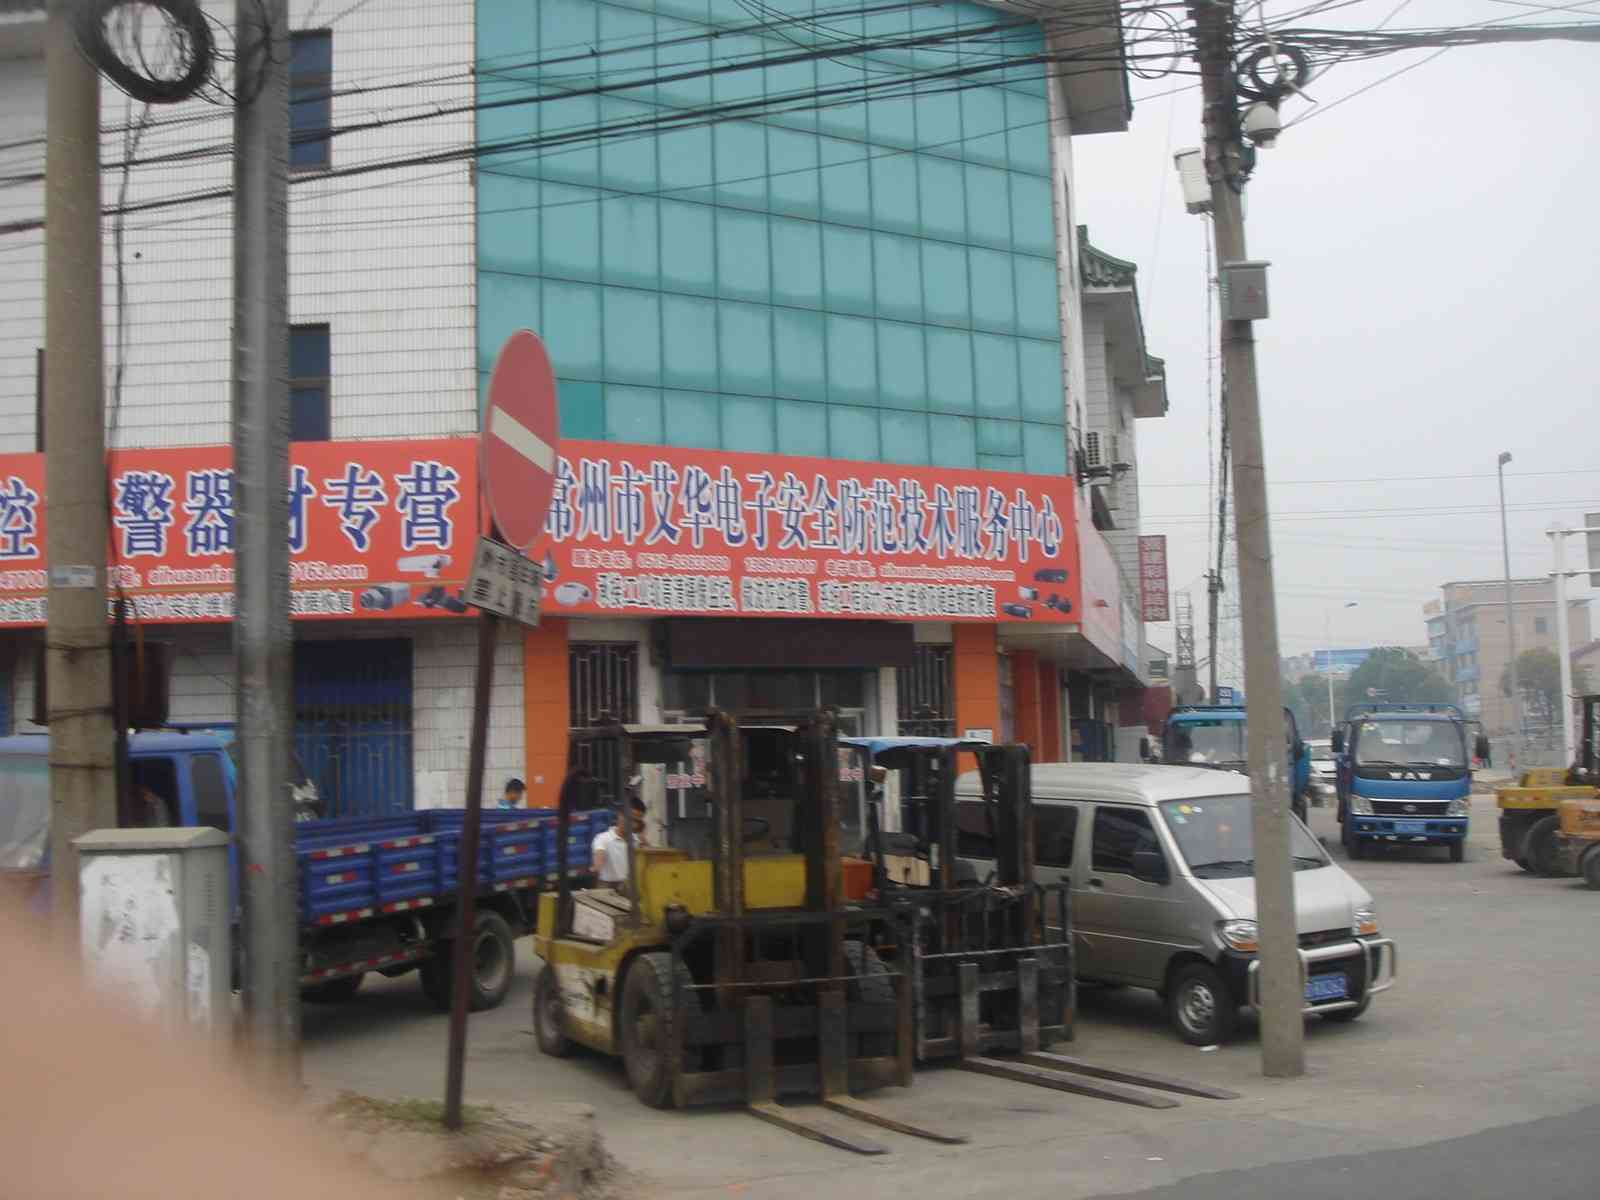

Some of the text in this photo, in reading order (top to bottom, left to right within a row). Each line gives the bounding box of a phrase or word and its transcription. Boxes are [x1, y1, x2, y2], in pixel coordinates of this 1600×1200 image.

[544, 456, 1063, 562] 常州市艾华电子安全防范技术服务中心
